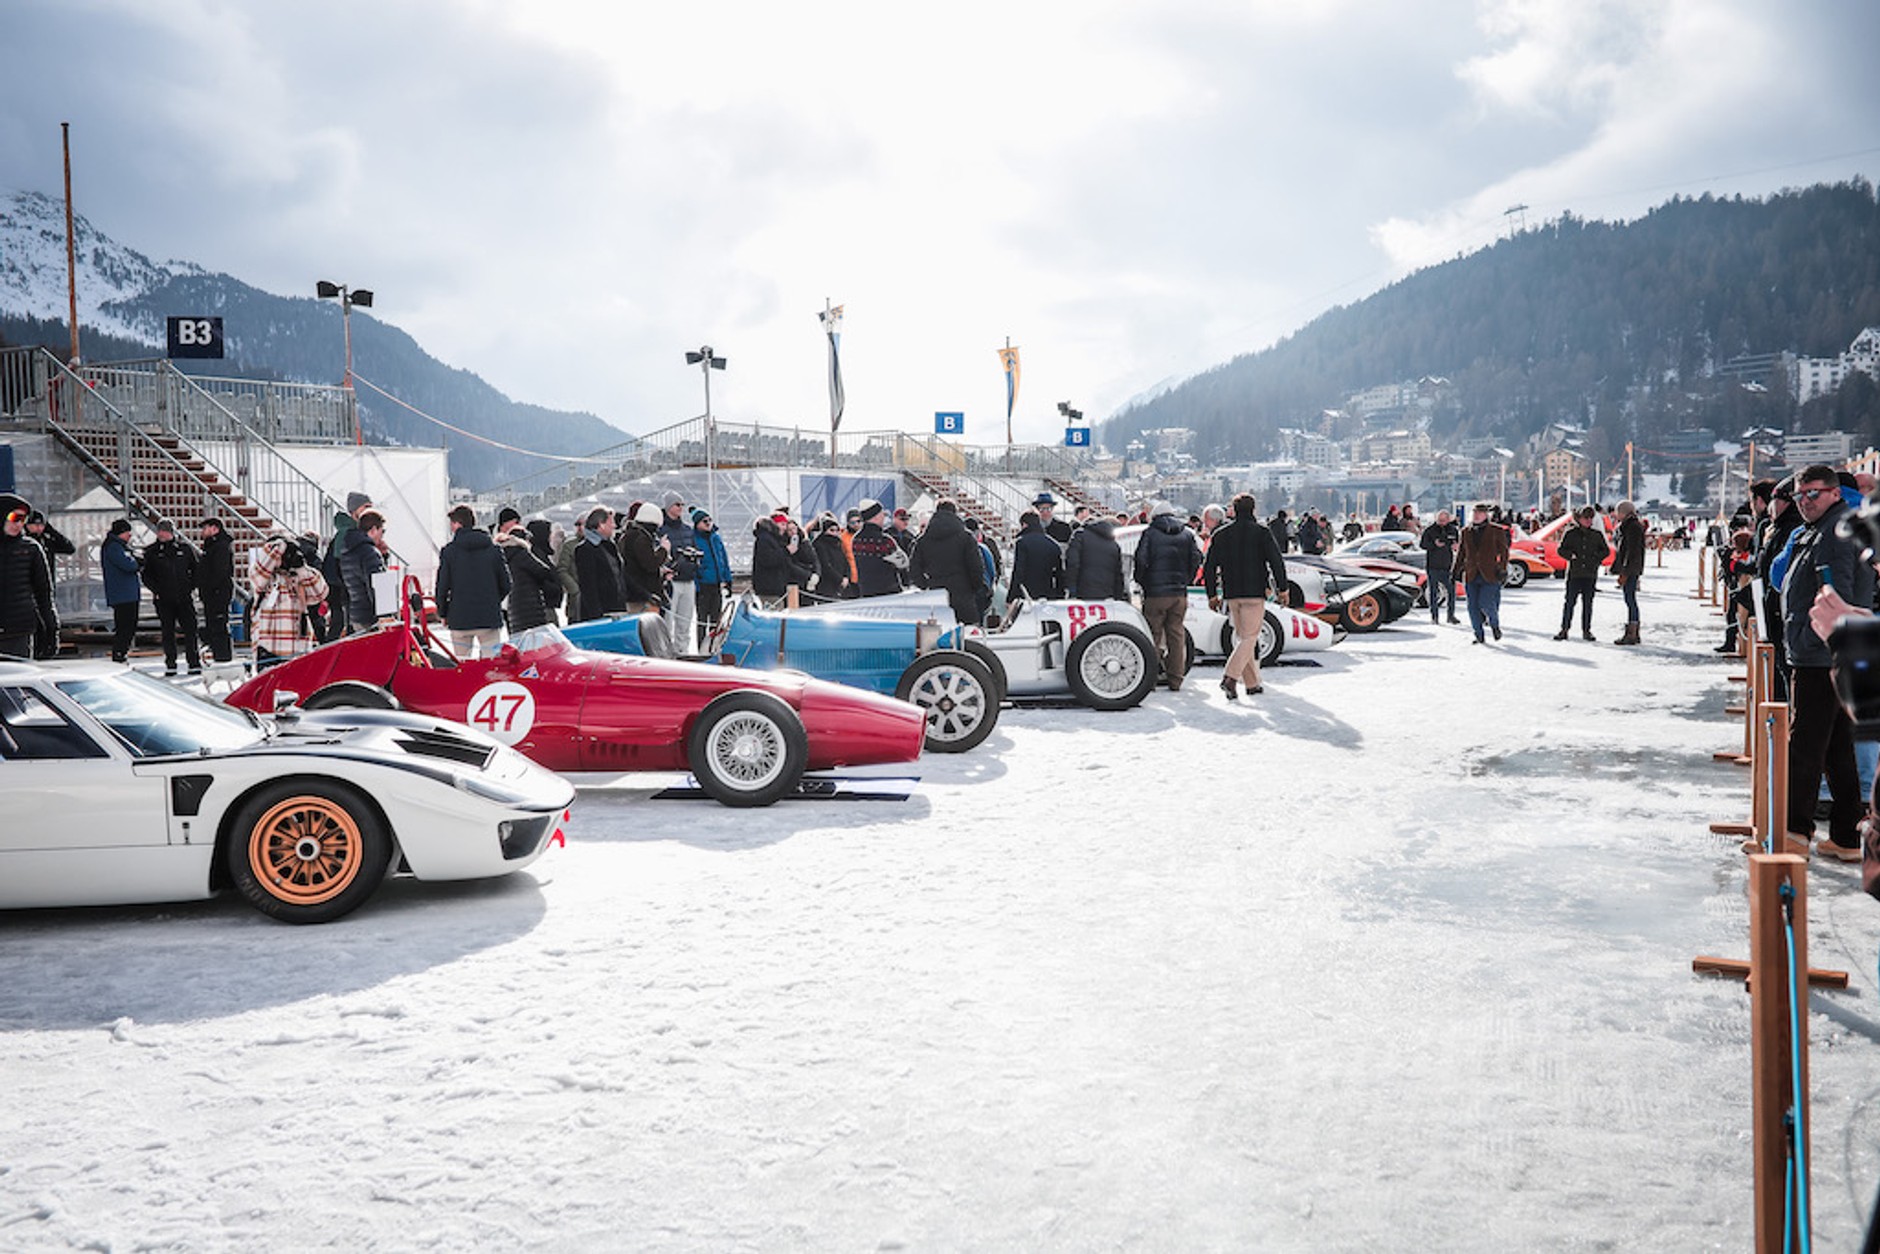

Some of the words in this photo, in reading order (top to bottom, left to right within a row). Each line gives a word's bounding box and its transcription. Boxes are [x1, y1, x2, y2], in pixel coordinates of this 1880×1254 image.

[178, 319, 212, 345] B3
[944, 417, 956, 431] B
[1072, 431, 1083, 444] B
[1291, 615, 1320, 640] 10
[473, 695, 527, 732] 47
